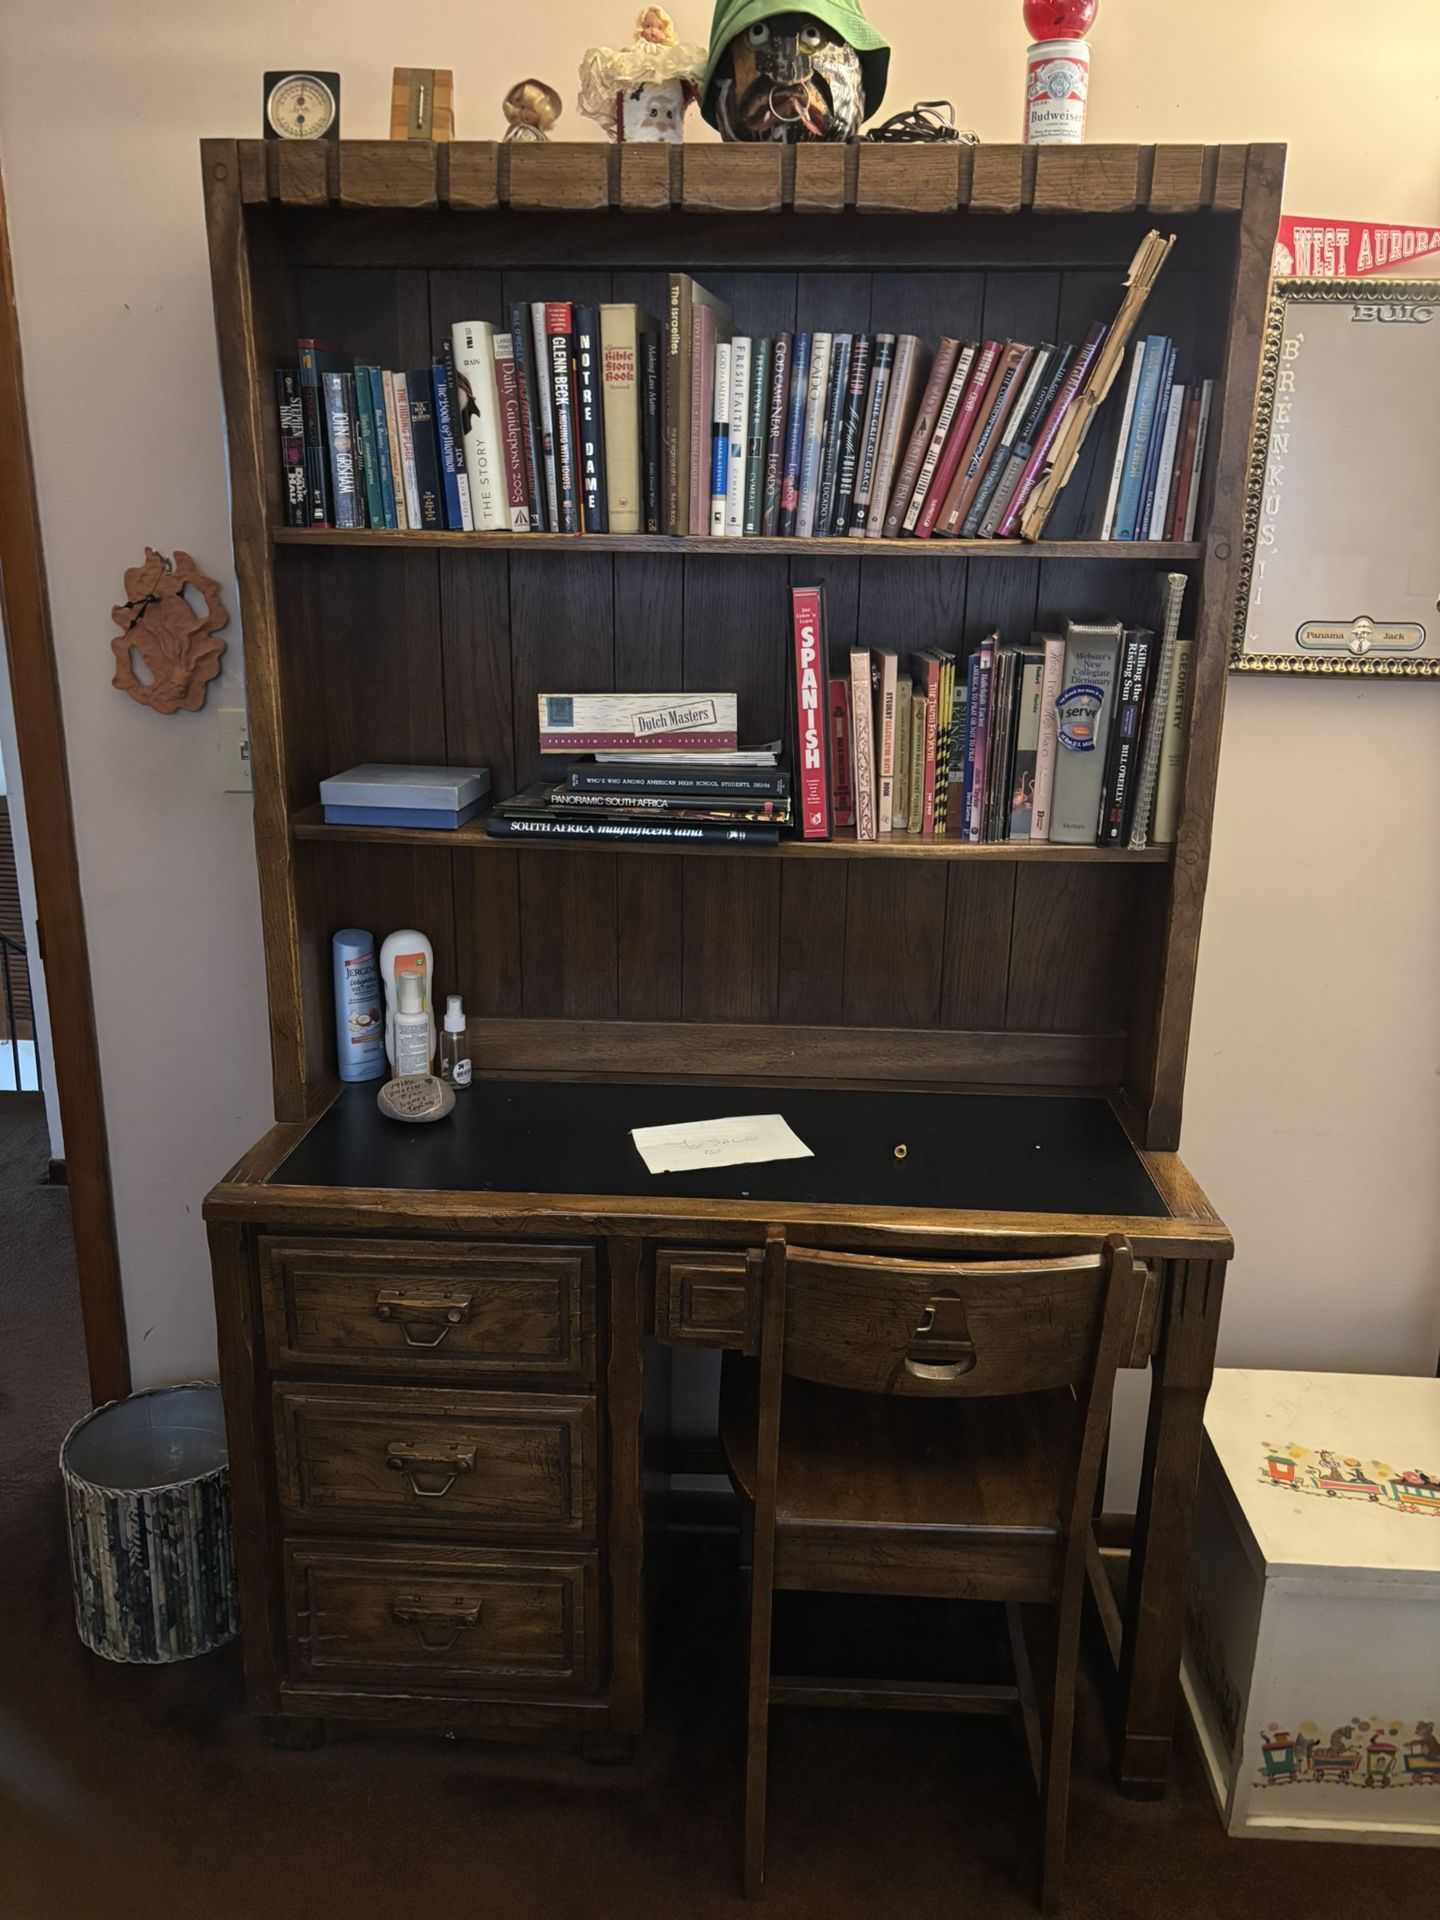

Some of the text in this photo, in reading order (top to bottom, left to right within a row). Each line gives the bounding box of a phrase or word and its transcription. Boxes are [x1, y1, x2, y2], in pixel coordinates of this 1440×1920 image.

[1293, 227, 1440, 276] WEST AURORA
[670, 286, 680, 355] The Israelites
[552, 337, 567, 373] GLENN
[605, 351, 634, 361] Bible
[605, 361, 634, 371] Story
[809, 339, 824, 400] LUCADO
[958, 352, 971, 368] THE
[437, 384, 448, 399] The
[555, 376, 569, 405] BECK
[606, 371, 634, 382] Book
[647, 345, 657, 416] Making Loss Matter
[733, 345, 746, 433] FRESH FAITH
[752, 355, 763, 424] FRESH POWER
[770, 342, 786, 438] GOD CAME NEAR
[1046, 365, 1066, 402] THE GOD
[1065, 363, 1085, 392] GOD
[1161, 353, 1176, 414] POWER FOR LIVING
[397, 389, 407, 403] THE
[439, 401, 451, 423] Book
[873, 402, 882, 417] THE
[986, 368, 1014, 425] THE COMMON
[1020, 383, 1049, 438] LOOKING FOR
[280, 405, 293, 429] KING
[290, 397, 304, 437] STEPHEN
[398, 405, 410, 433] HIDING
[501, 362, 523, 503] Daily Guideposts 2005
[579, 335, 598, 509] NOTRE DAME
[868, 418, 879, 442] GRIP
[332, 412, 354, 494] JOHN GRISHAM
[558, 409, 571, 490] ARGUING WITH IDIOTS
[866, 445, 874, 458] OF
[1130, 402, 1154, 478] SHOULD PERISH
[767, 453, 779, 496] LUCADO
[892, 437, 923, 508] JUST LIKE JESUS
[925, 449, 937, 466] JACK
[288, 473, 297, 505] HALF
[475, 439, 493, 520] THE STORY
[787, 463, 797, 500] LUCADO
[861, 461, 872, 493] GRACE
[820, 482, 831, 516] LUCADO
[1142, 491, 1153, 533] BUCKINGHAM
[1306, 632, 1405, 640] Panama Jack
[1073, 668, 1110, 677] Collegiate
[1076, 652, 1111, 660] Webster's
[1122, 643, 1138, 701] Rising Sun
[1132, 644, 1147, 701] Killing the
[801, 626, 820, 769] SPANISH
[971, 693, 977, 701] TO
[1070, 676, 1110, 685] Dictionary
[1173, 652, 1189, 730] GEOMETRY
[885, 692, 893, 719] STUDENT
[978, 674, 988, 727] Hallelujah Factor
[1032, 693, 1040, 713] Florida
[1066, 707, 1097, 717] serve
[638, 708, 709, 733] Dutch Masters
[927, 682, 937, 761] THE TRUTH FOR YOUTH
[949, 706, 959, 752] KING
[970, 717, 976, 725] OR
[884, 720, 892, 757] CALCULATOR
[969, 739, 975, 747] TO
[586, 777, 604, 785] WHO'S
[913, 776, 921, 794] SHORT
[972, 768, 983, 808] Jack Taylor
[1115, 744, 1130, 803] BILL O'REILLY
[551, 795, 668, 808] PANORAMIC SOUTH AFRICA
[510, 821, 551, 832] SOUTH
[552, 823, 595, 834] AFRICA
[346, 966, 376, 979] JERGEN
